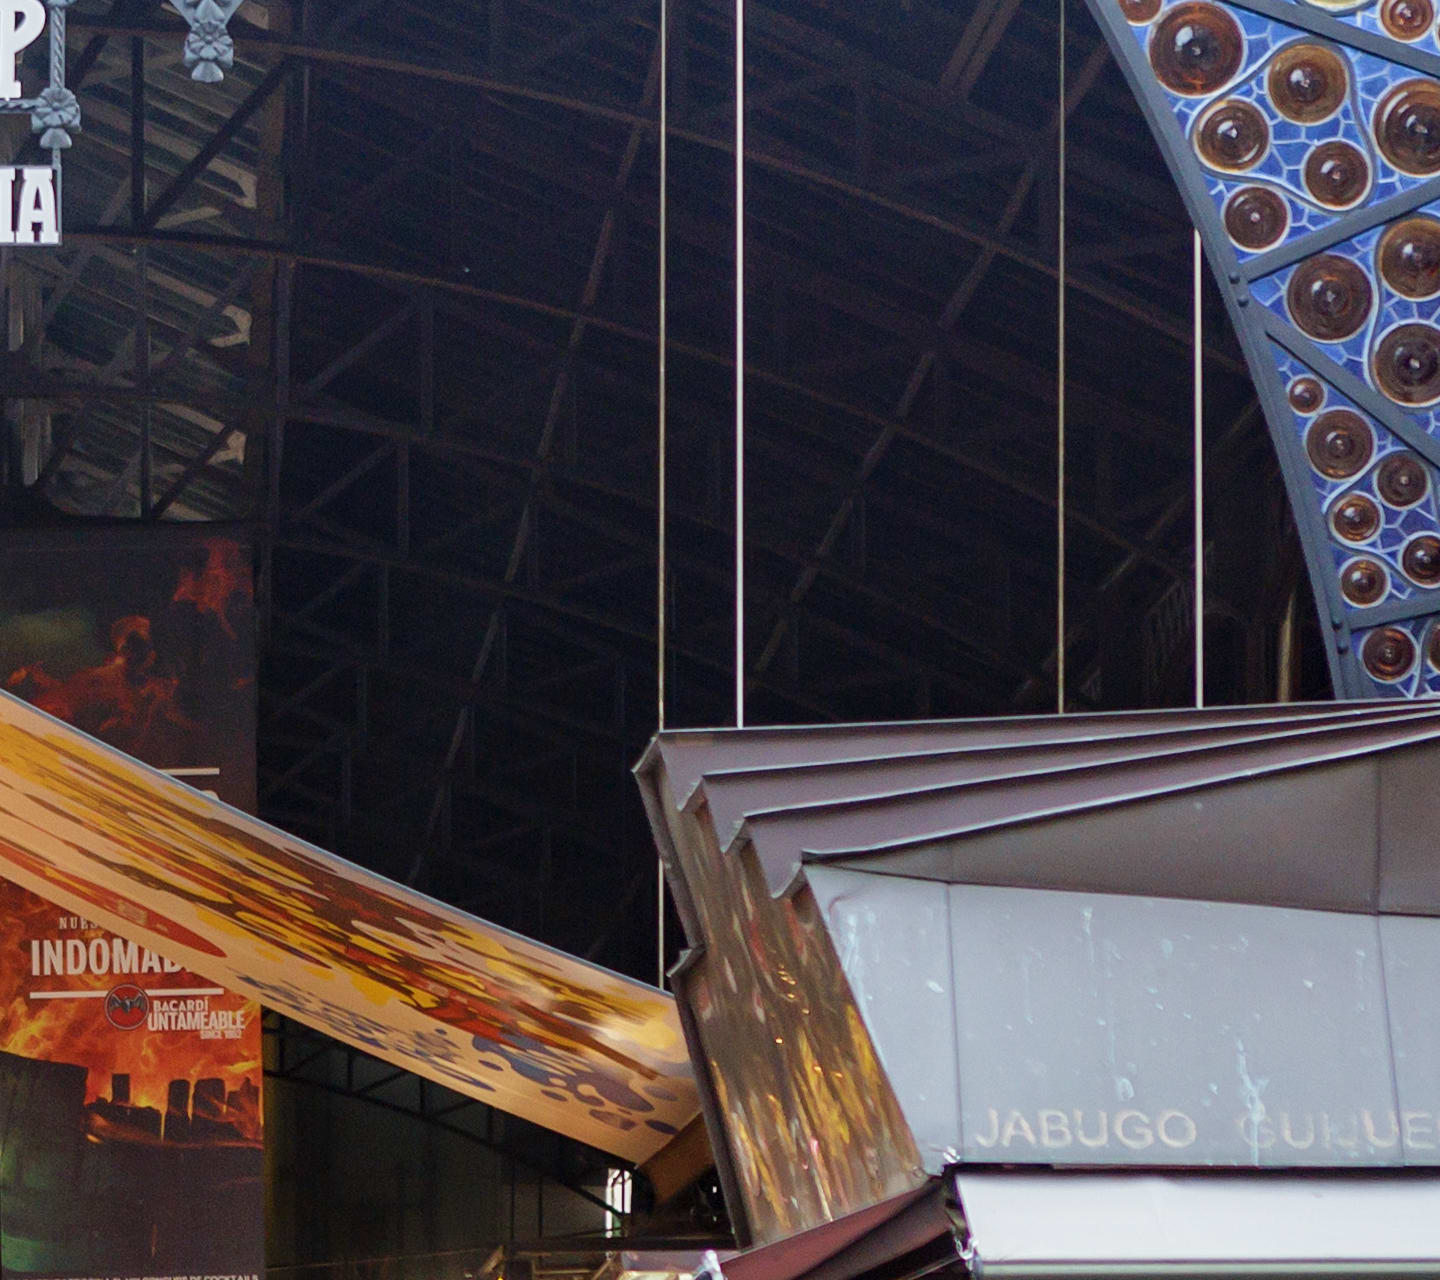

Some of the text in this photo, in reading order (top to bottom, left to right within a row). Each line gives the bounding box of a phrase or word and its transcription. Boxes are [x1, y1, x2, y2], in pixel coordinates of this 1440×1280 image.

[59, 917, 99, 929] NUES
[31, 938, 193, 976] INDOMA
[147, 1010, 245, 1031] UNTAMEABLE
[976, 1108, 1196, 1149] JABUGO
